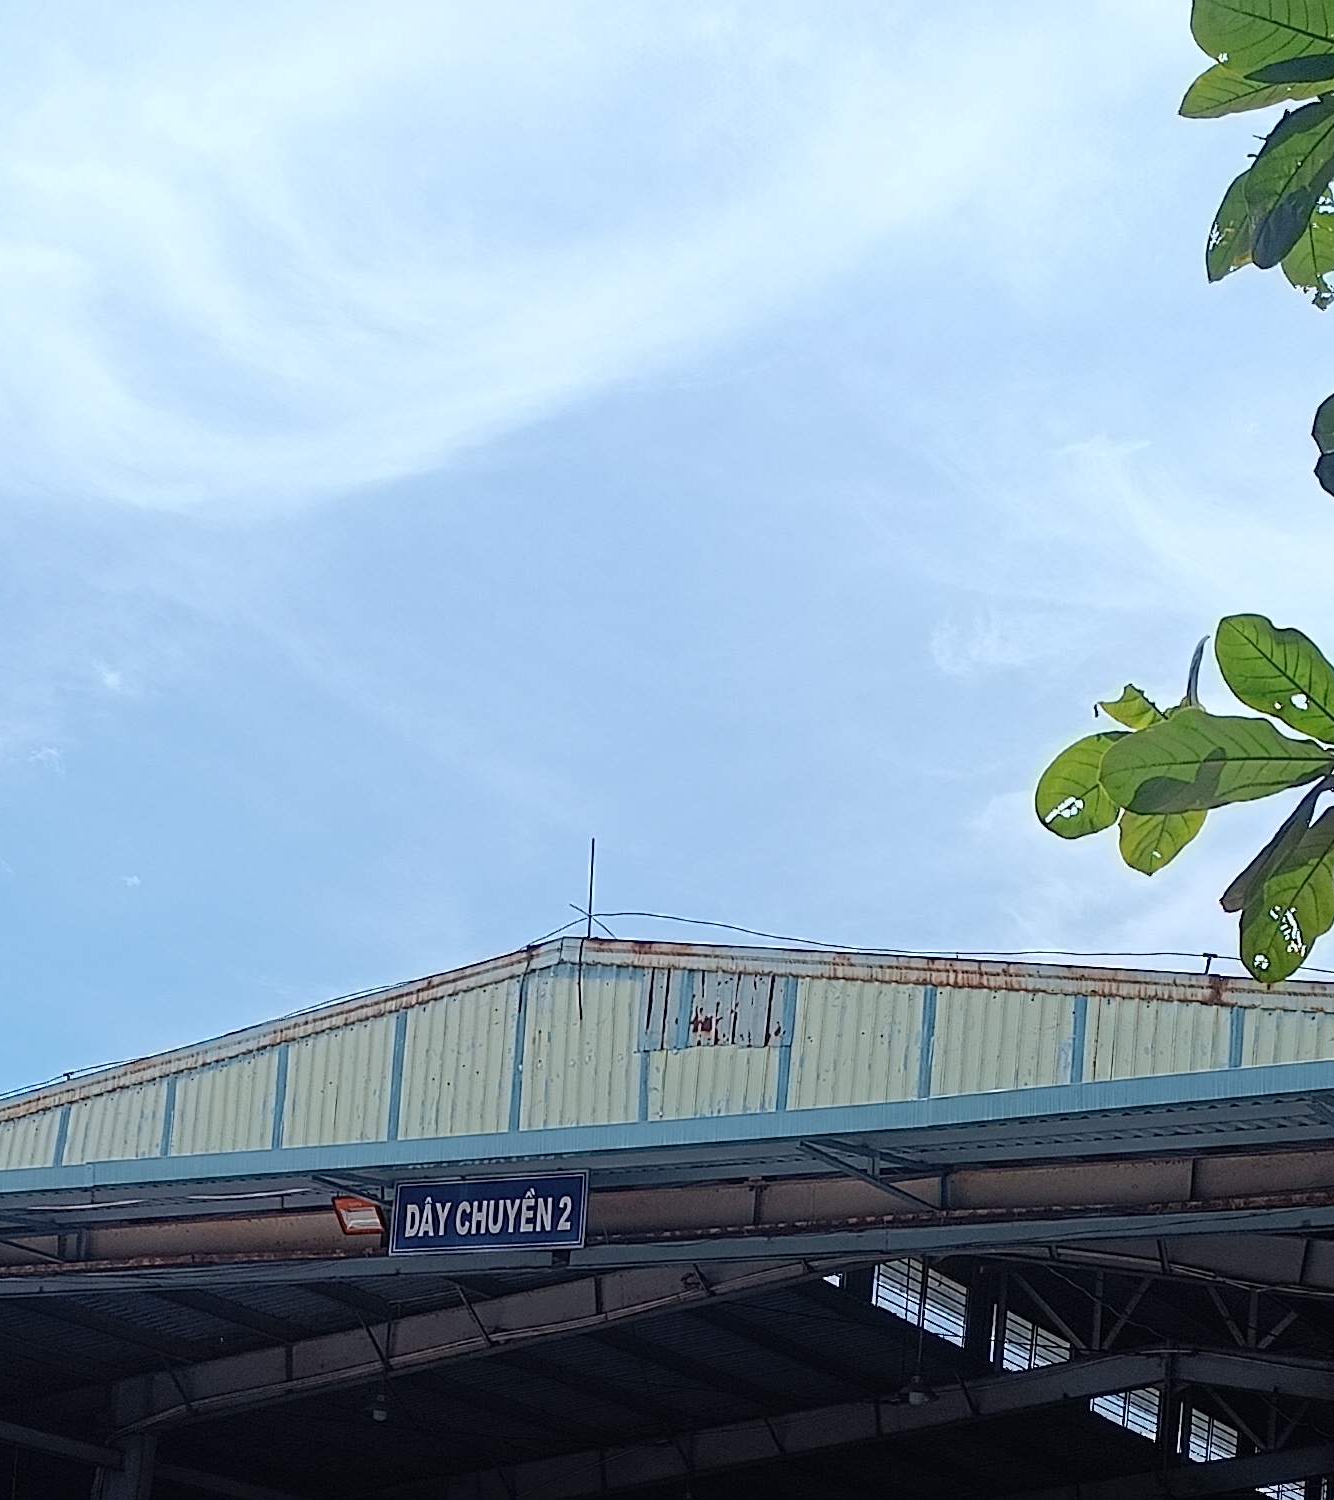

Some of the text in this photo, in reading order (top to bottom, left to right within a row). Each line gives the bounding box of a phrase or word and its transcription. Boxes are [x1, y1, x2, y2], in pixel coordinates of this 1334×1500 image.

[404, 1187, 573, 1238] DÂY CHUYỀN 2
